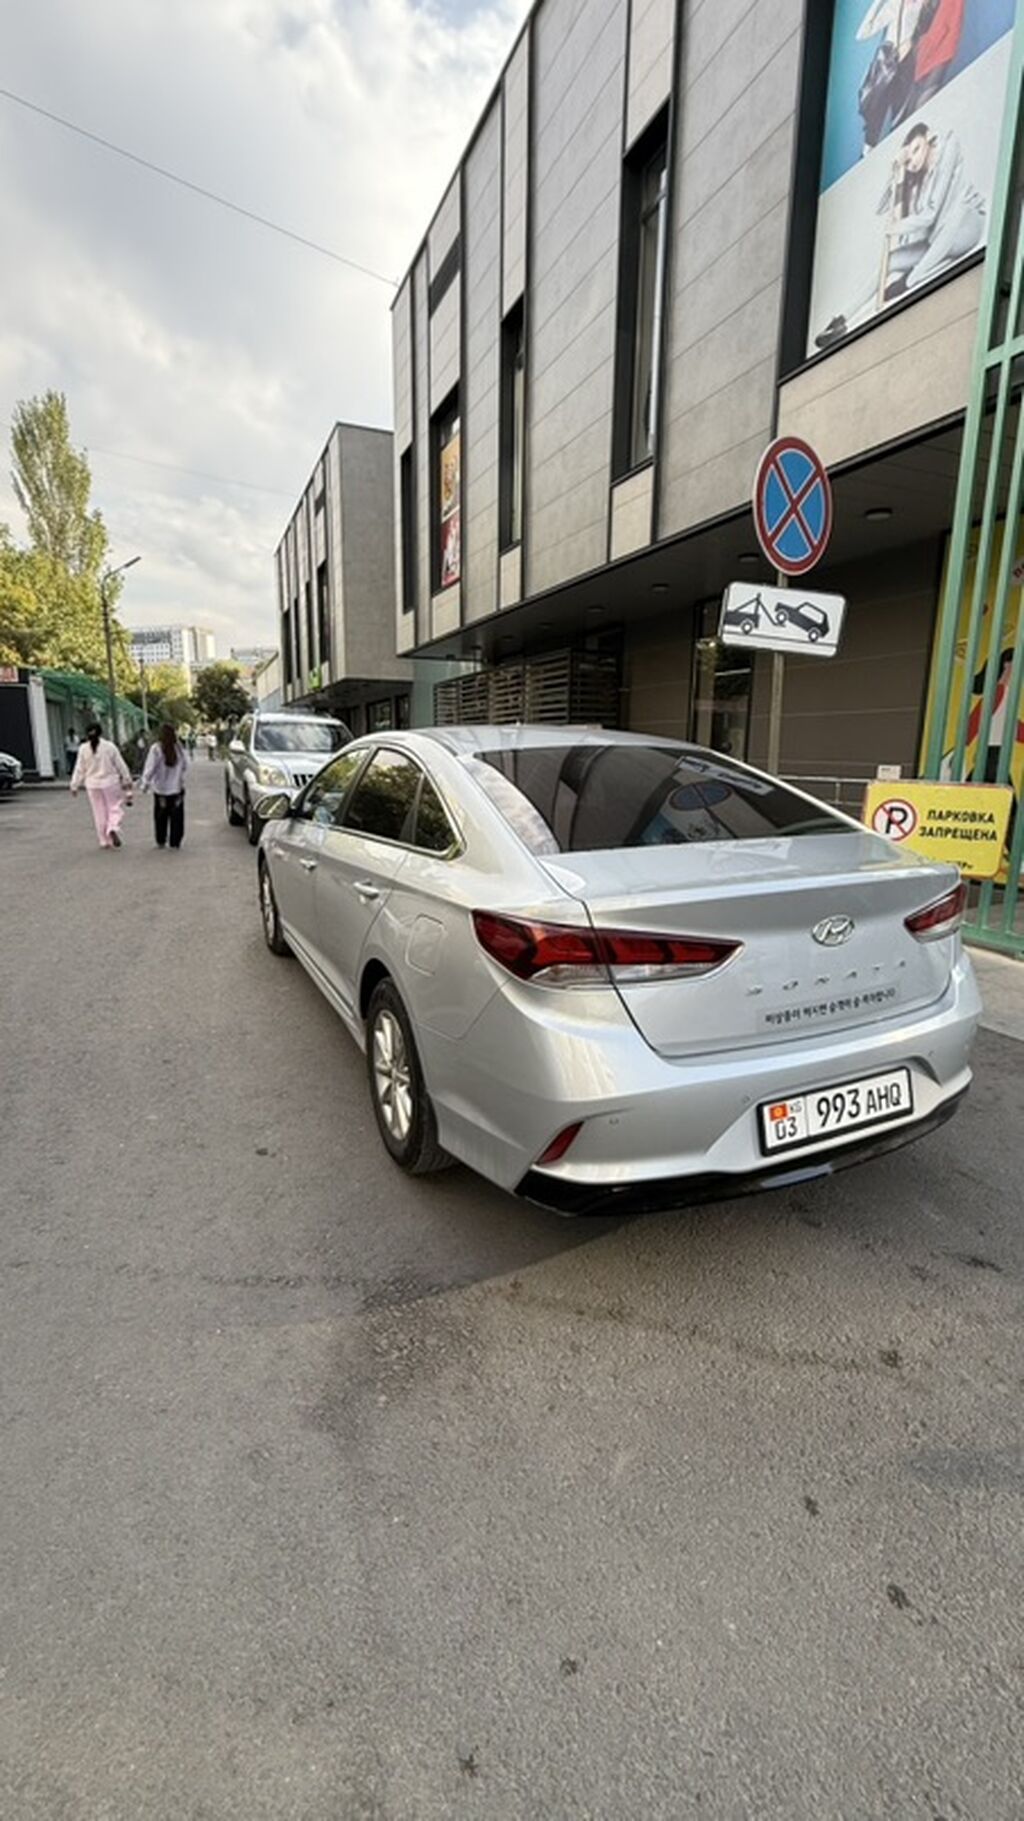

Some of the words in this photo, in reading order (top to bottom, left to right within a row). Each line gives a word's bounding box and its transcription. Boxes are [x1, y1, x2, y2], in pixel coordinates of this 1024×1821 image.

[927, 808, 995, 824] ПАРКОВКА
[919, 826, 997, 841] ЗАПРЕЩЕНА
[746, 961, 906, 996] SONATA
[790, 1100, 802, 1113] KG
[816, 1088, 861, 1127] 993
[866, 1083, 902, 1114] AHQ
[775, 1116, 798, 1140] 03
